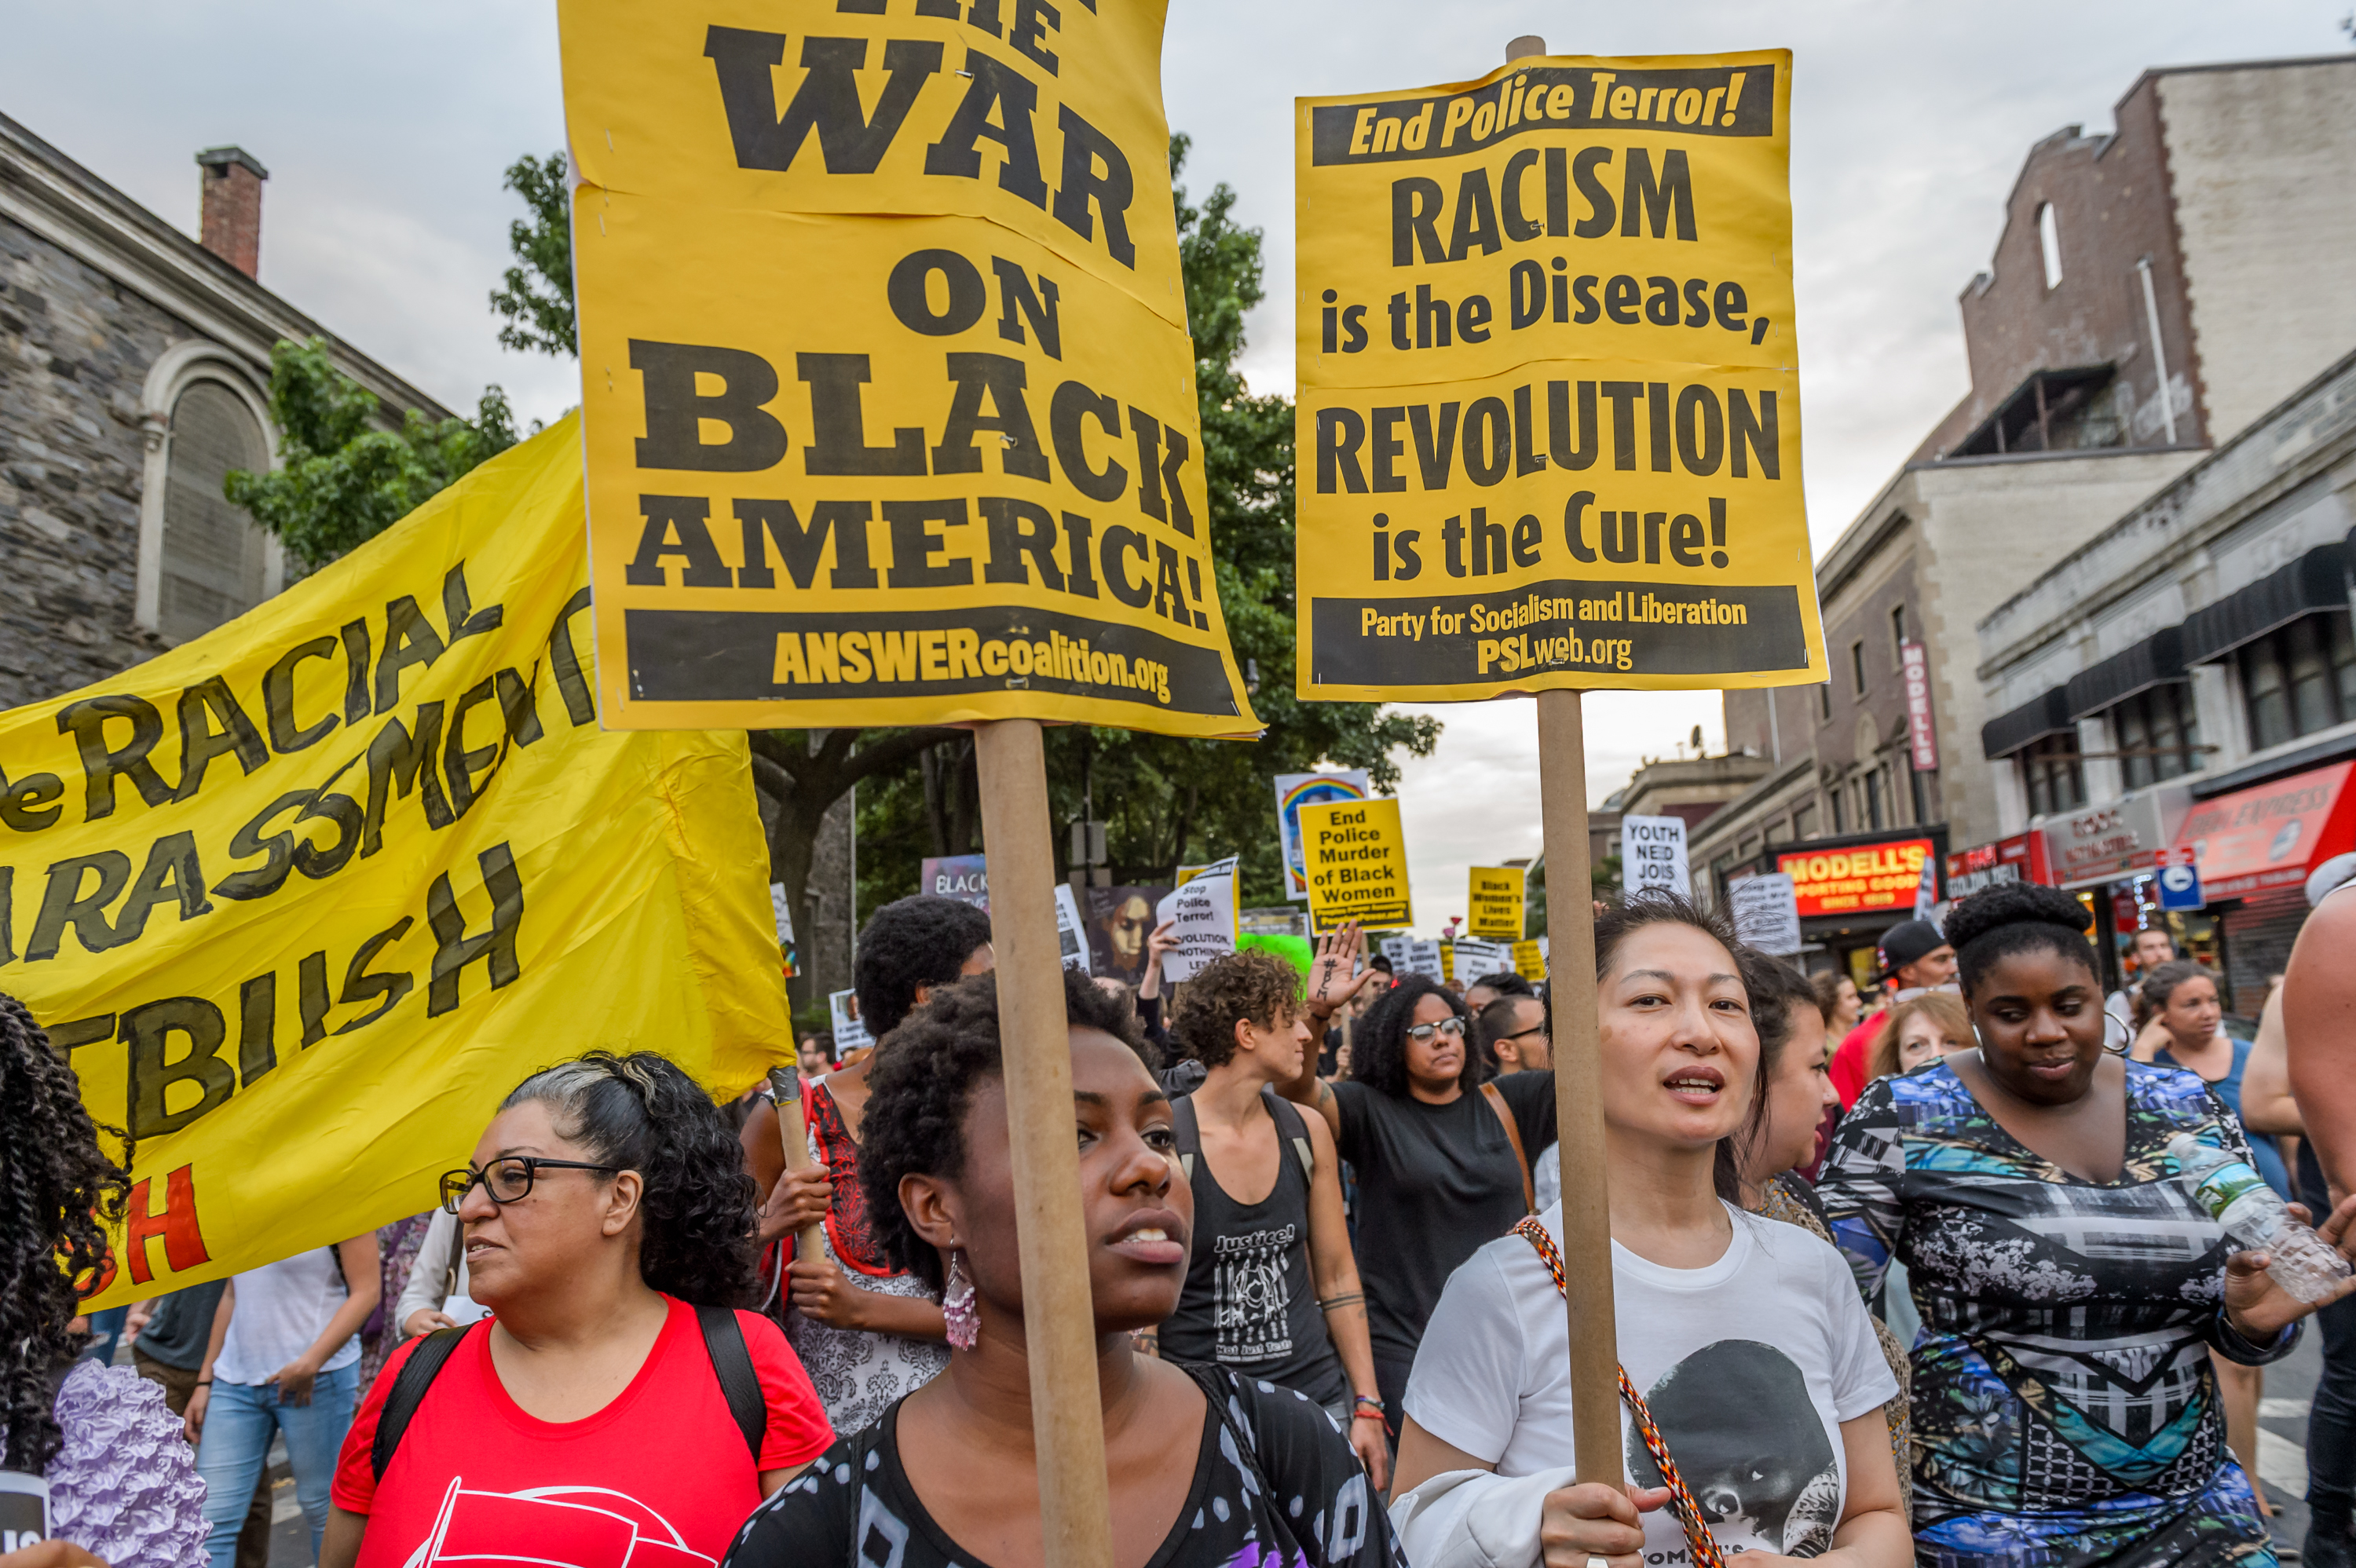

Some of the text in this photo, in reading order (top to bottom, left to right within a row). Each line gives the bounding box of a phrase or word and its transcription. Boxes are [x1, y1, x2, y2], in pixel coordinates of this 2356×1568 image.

[1348, 71, 1747, 155] End Police Terror!
[703, 24, 1135, 271] WAR
[1392, 146, 1697, 267] RACISM
[888, 249, 1062, 362] ON
[1322, 257, 1770, 353] is the Disease,
[628, 338, 1195, 539] BLACK
[1316, 381, 1780, 495] REVOLUTION
[1372, 491, 1729, 581] is the Cure!
[625, 494, 1210, 632] AMERICA!
[1362, 592, 1747, 642] Party for Socialism and Liberation
[772, 629, 1172, 704] ANSWERcoalition.org
[1478, 627, 1633, 674] PSLweb.org
[56, 559, 503, 824] RACIAL
[1330, 810, 1366, 826] End
[1629, 825, 1679, 842] YOUTH
[1319, 828, 1380, 846] Police
[1637, 845, 1674, 861] NEED
[1319, 845, 1390, 864] Murder
[1783, 846, 1926, 883] MODELL'S
[1183, 886, 1206, 895] Stop
[1314, 864, 1395, 886] of Black
[1794, 878, 1868, 898] PORTING
[1868, 873, 1922, 892] GOOD
[1177, 898, 1211, 908] Police
[1322, 886, 1396, 904] Women
[1176, 912, 1215, 923] Terror!
[1178, 934, 1231, 945] VOLUTION,
[1178, 947, 1219, 957] NOTHIN
[1214, 1223, 1295, 1253] Justice!
